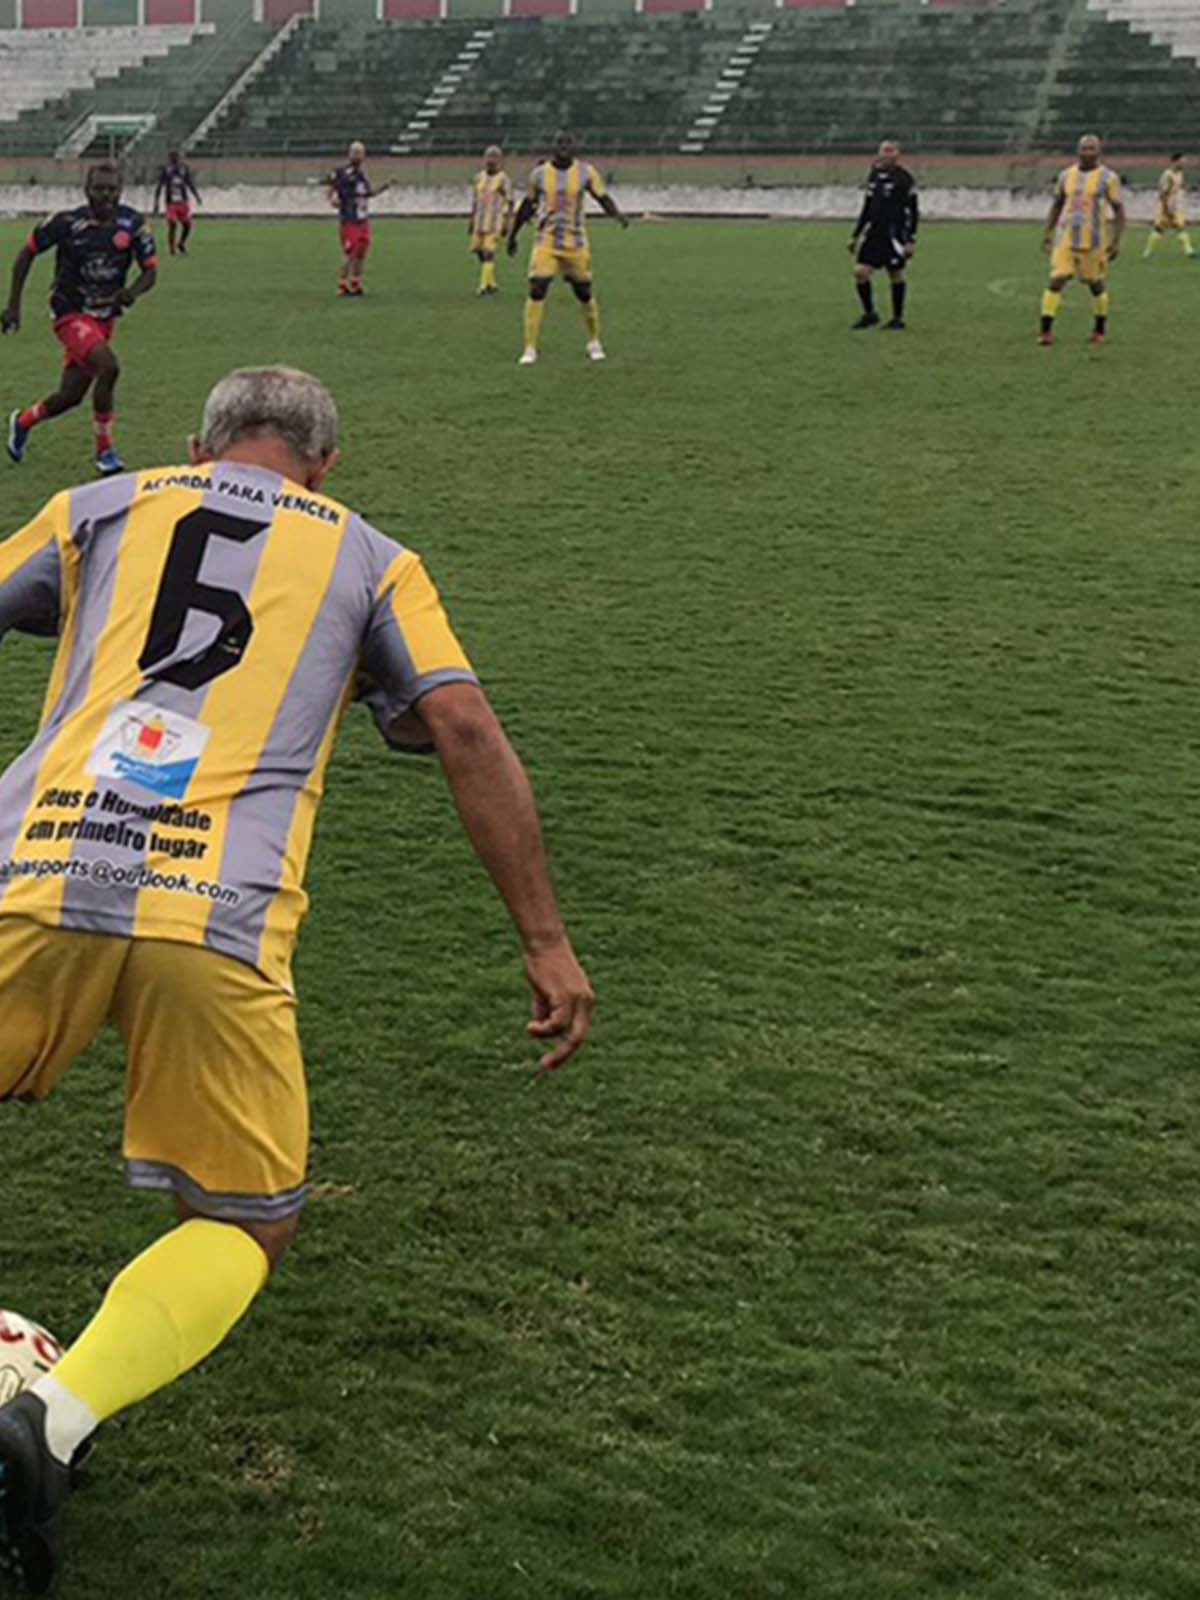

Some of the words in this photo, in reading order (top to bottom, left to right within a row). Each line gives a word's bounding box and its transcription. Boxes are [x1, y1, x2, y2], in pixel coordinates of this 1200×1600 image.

[218, 479, 265, 503] PARA
[271, 493, 341, 525] VENCER
[137, 506, 272, 692] 6
[25, 819, 55, 841] em
[56, 817, 146, 852] primeiro
[149, 834, 209, 860] lugar
